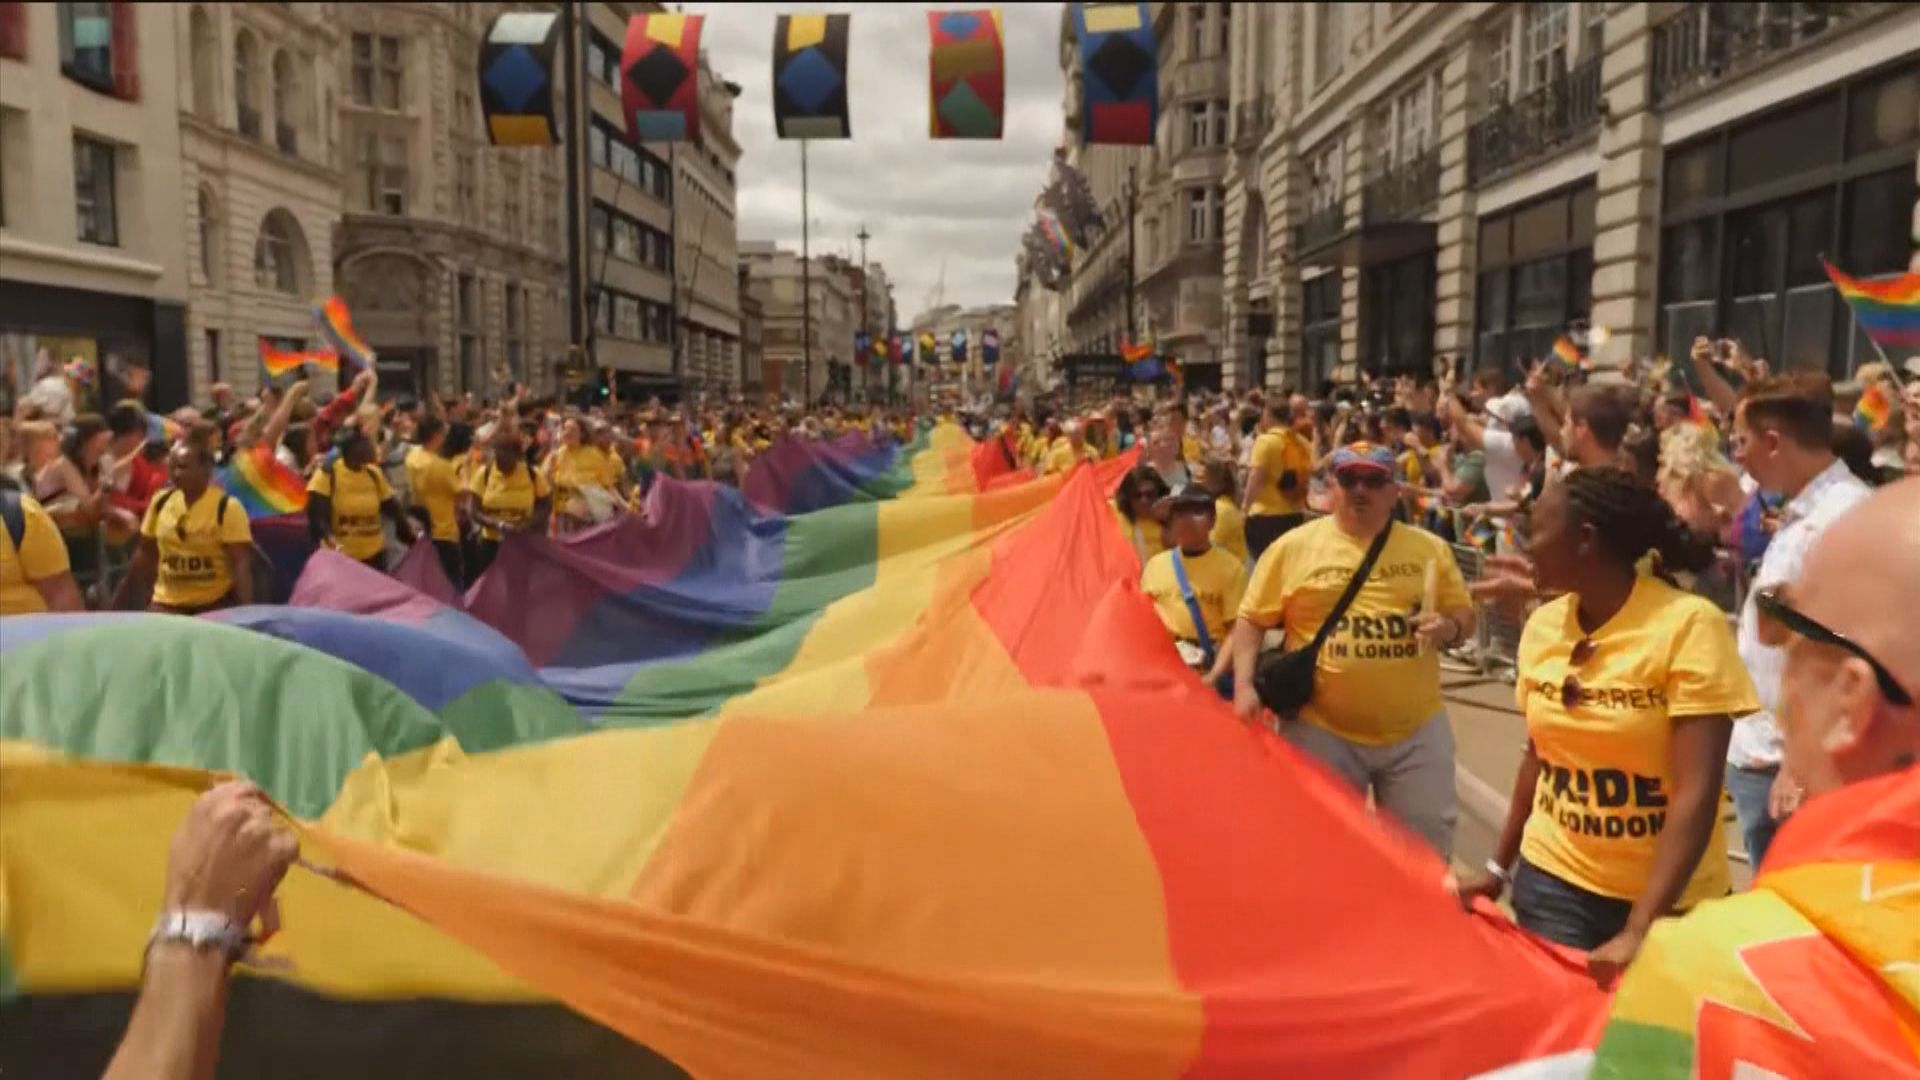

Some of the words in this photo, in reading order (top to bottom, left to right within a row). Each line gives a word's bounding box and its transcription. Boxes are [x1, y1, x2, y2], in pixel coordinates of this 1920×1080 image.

[1328, 643, 1348, 658] IN
[1354, 643, 1417, 659] LONDO
[1558, 808, 1667, 838] LONDON
